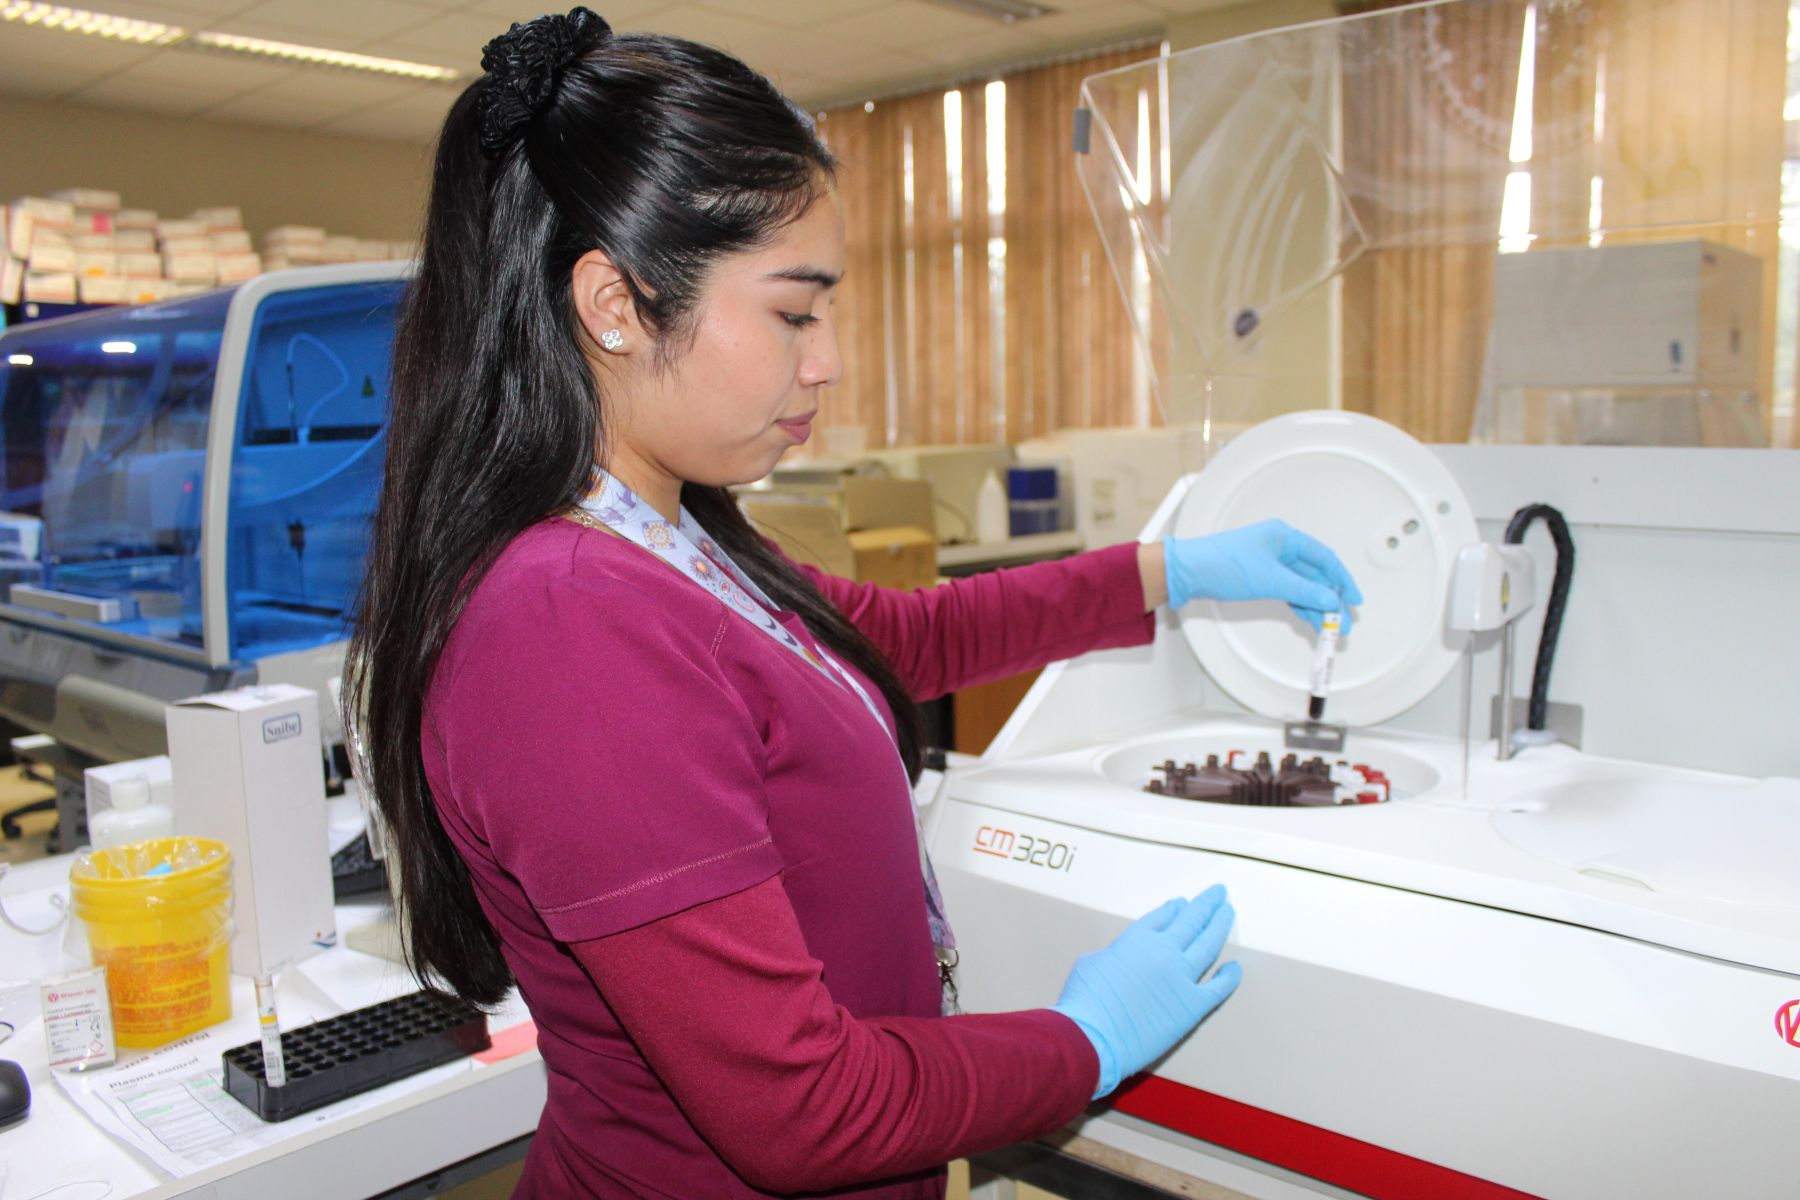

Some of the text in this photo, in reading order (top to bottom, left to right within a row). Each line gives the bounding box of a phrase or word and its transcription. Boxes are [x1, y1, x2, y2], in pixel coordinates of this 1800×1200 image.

[266, 719, 298, 736] Snibe
[109, 1072, 154, 1089] Plasma
[158, 1056, 199, 1075] control
